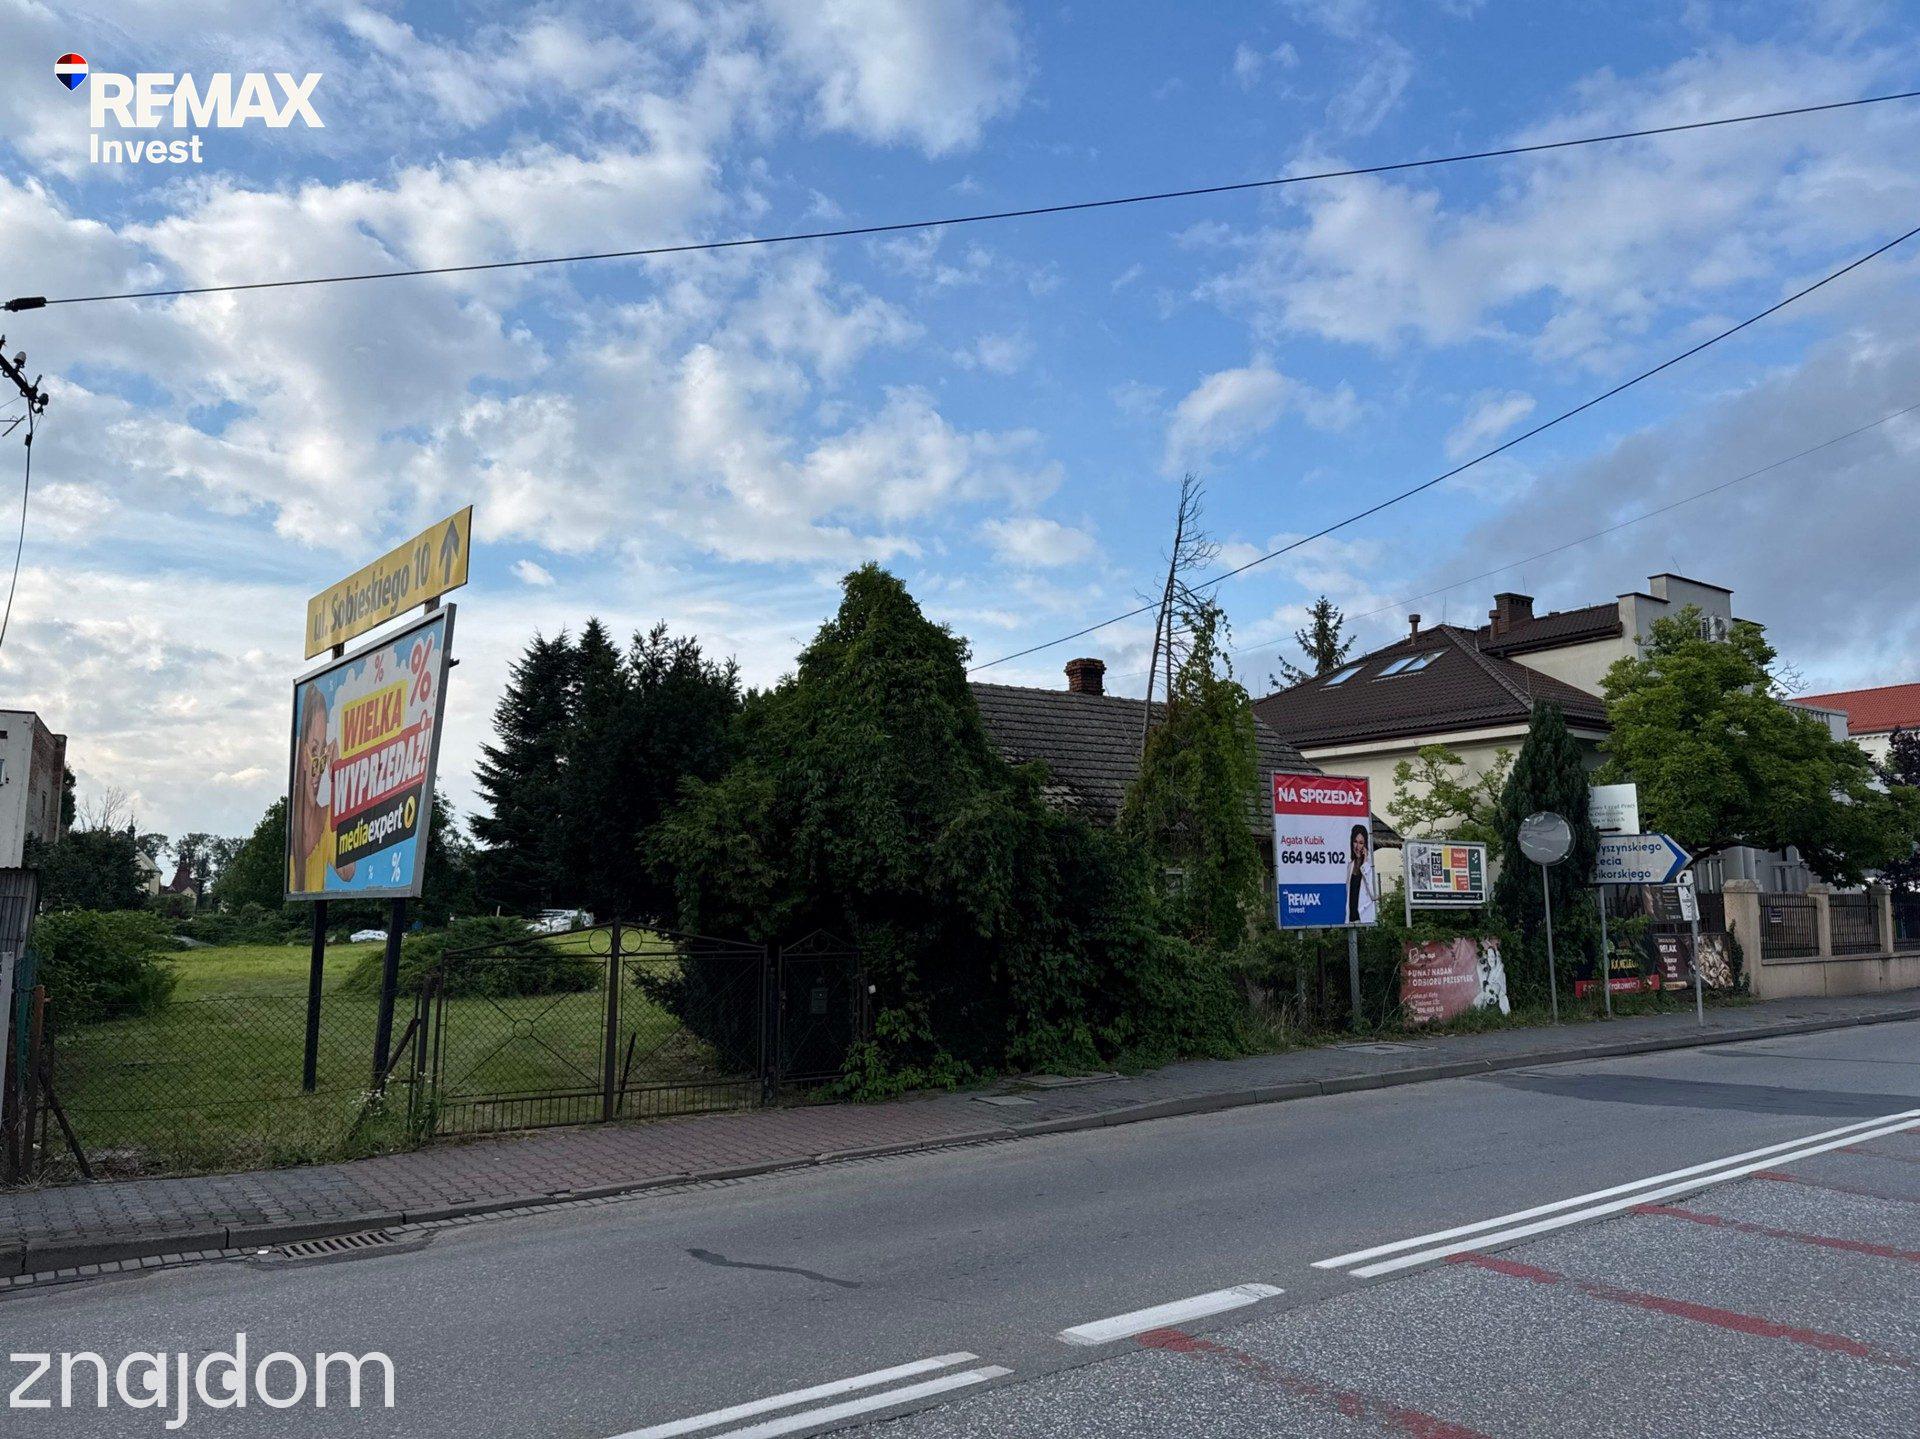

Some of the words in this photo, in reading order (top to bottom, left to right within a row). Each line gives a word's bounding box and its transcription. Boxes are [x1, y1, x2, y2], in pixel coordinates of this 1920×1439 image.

[313, 600, 328, 642] ul.
[330, 564, 410, 633] Sobieskiego
[413, 542, 431, 590] 10
[343, 687, 404, 752] WIELKA
[334, 709, 431, 817] WYPRZEDAŻ!
[1278, 787, 1298, 803] NA
[1300, 788, 1364, 806] SPRZEDAŻ
[338, 802, 404, 856] mediaexpert
[1281, 836, 1303, 847] Agata
[1304, 836, 1325, 846] Kubik
[1282, 851, 1303, 864] 664
[1305, 851, 1326, 864] 945
[1328, 851, 1346, 864] 102
[1288, 893, 1321, 906] REMAX
[1288, 906, 1305, 914] Invest
